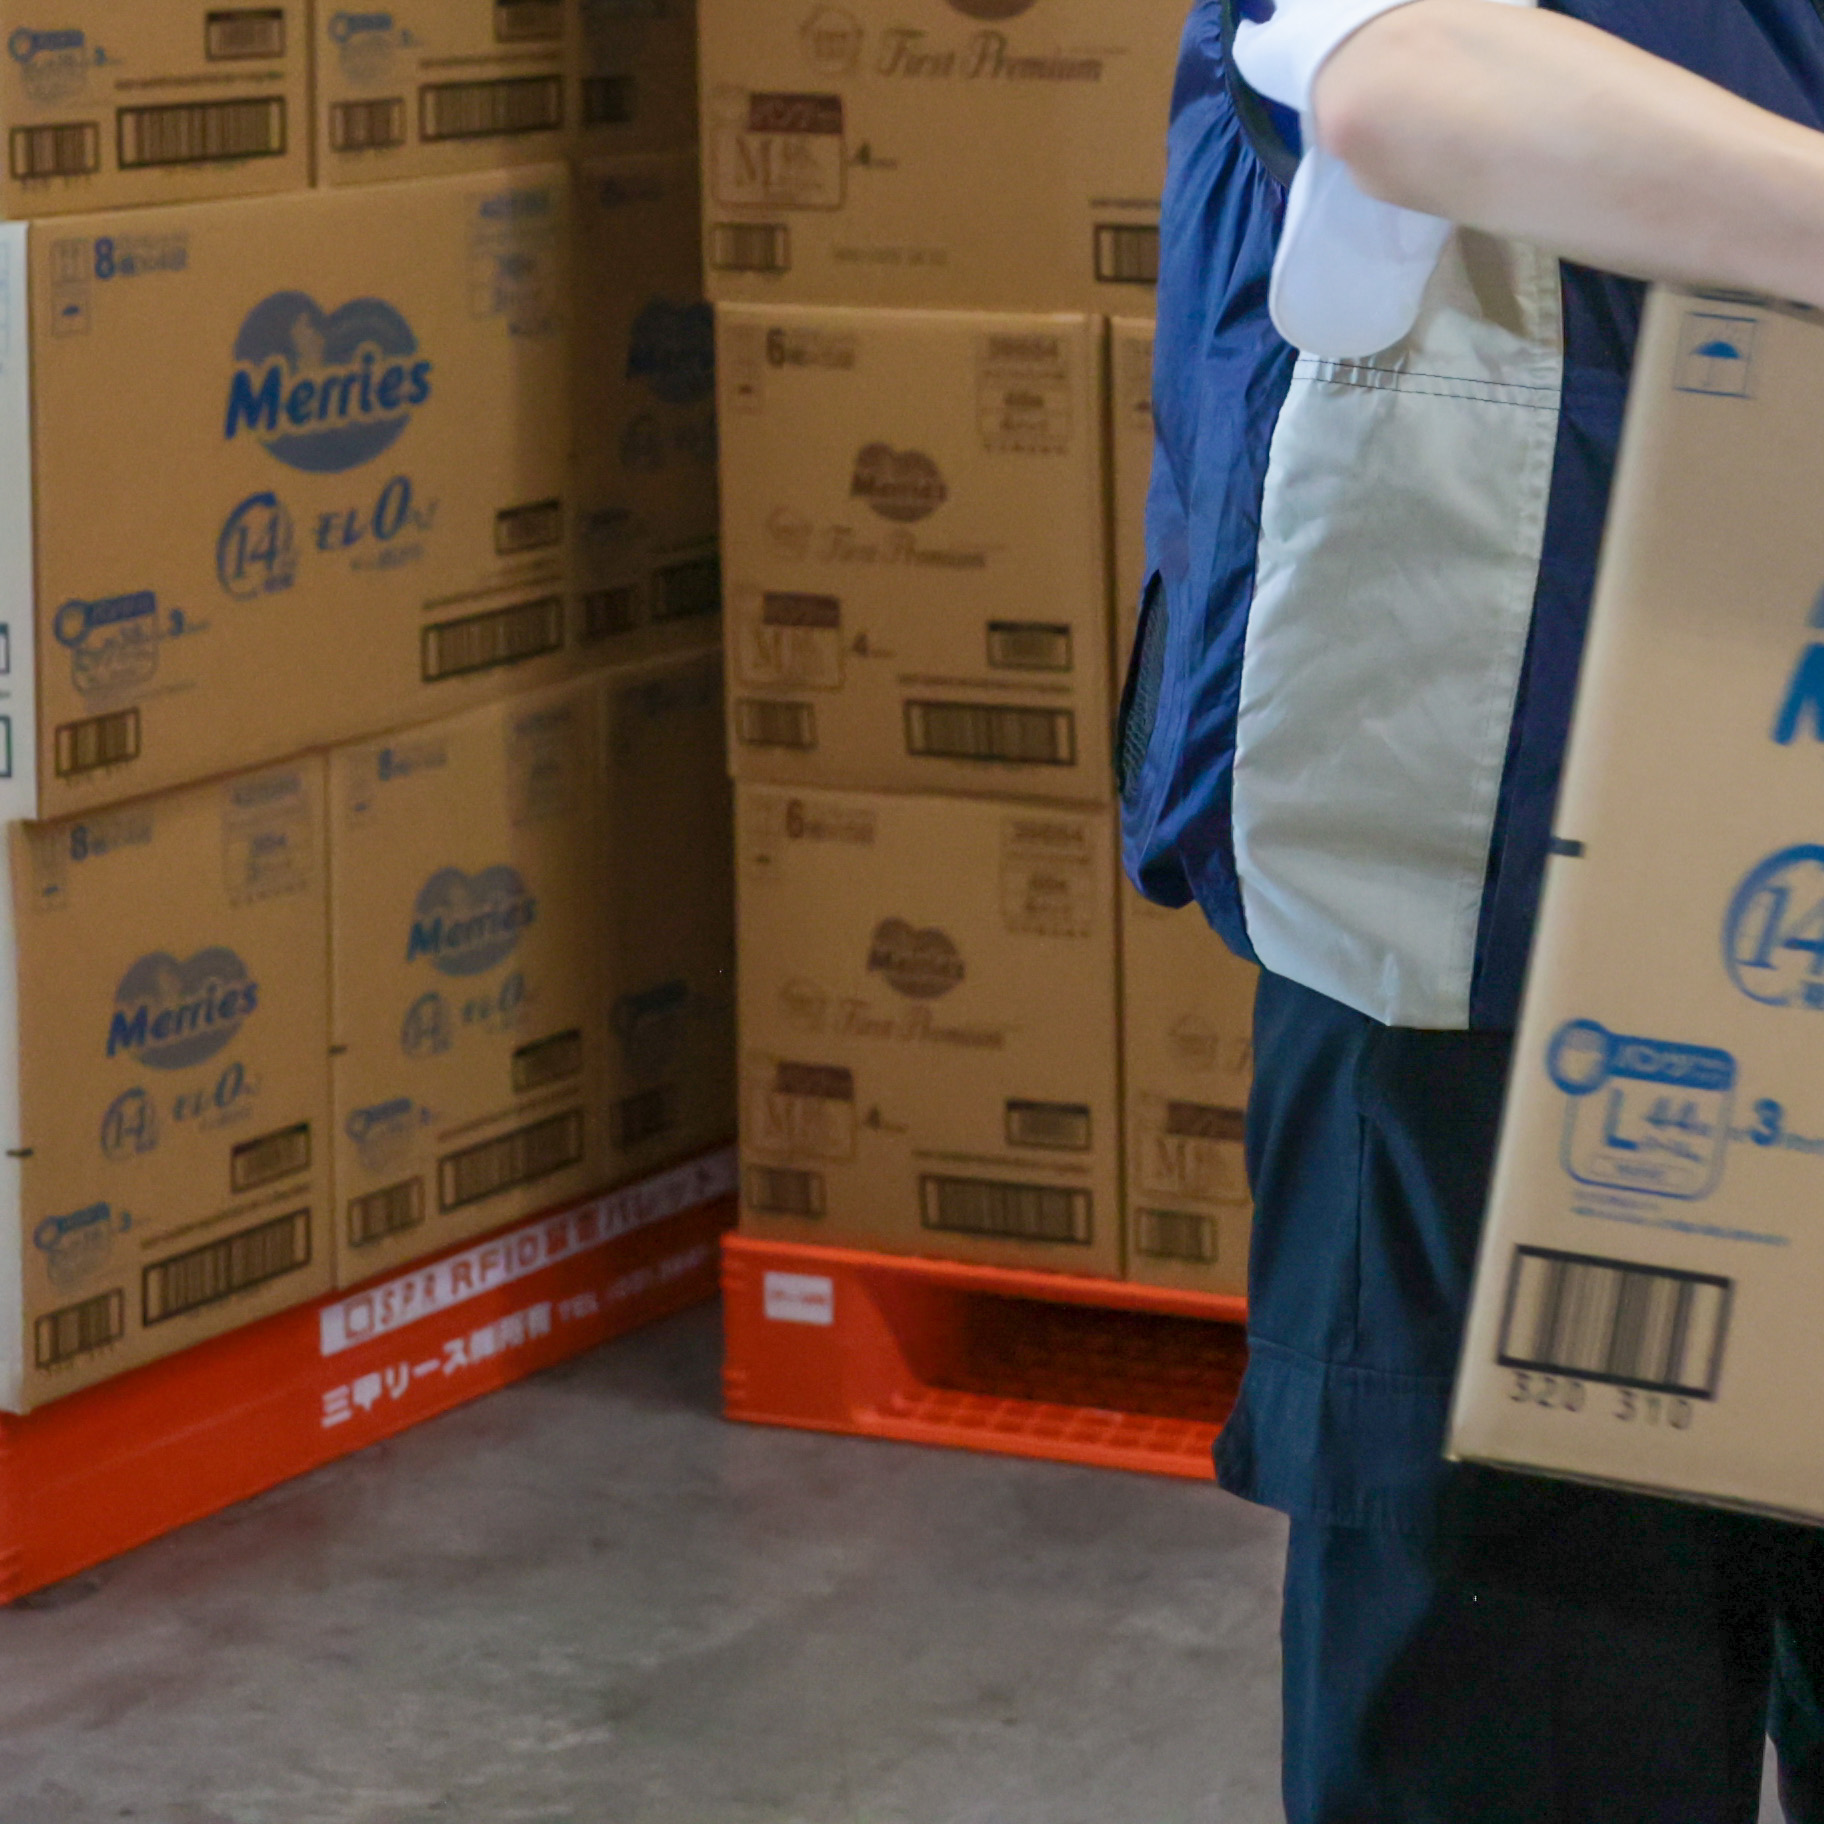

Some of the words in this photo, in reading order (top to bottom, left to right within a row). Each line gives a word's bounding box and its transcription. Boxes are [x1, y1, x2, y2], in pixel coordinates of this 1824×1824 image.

[224, 356, 432, 438] Merries
[406, 896, 536, 960] Merries
[107, 980, 258, 1056] Merries
